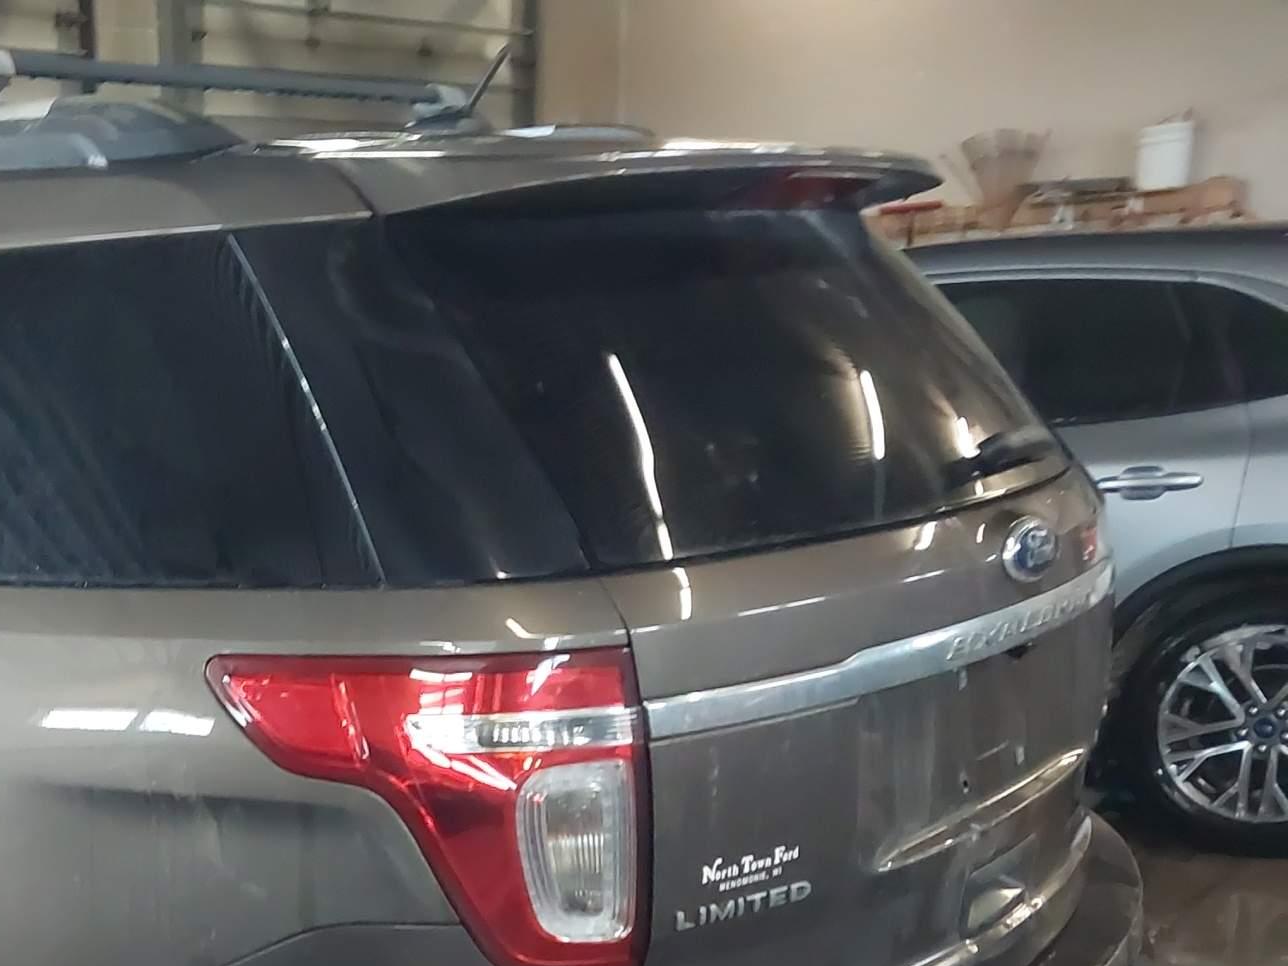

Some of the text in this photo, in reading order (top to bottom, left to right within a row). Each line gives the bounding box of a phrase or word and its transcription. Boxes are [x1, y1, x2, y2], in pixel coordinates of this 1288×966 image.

[702, 845, 800, 885] North Town Ford
[676, 880, 812, 931] LIMITED
